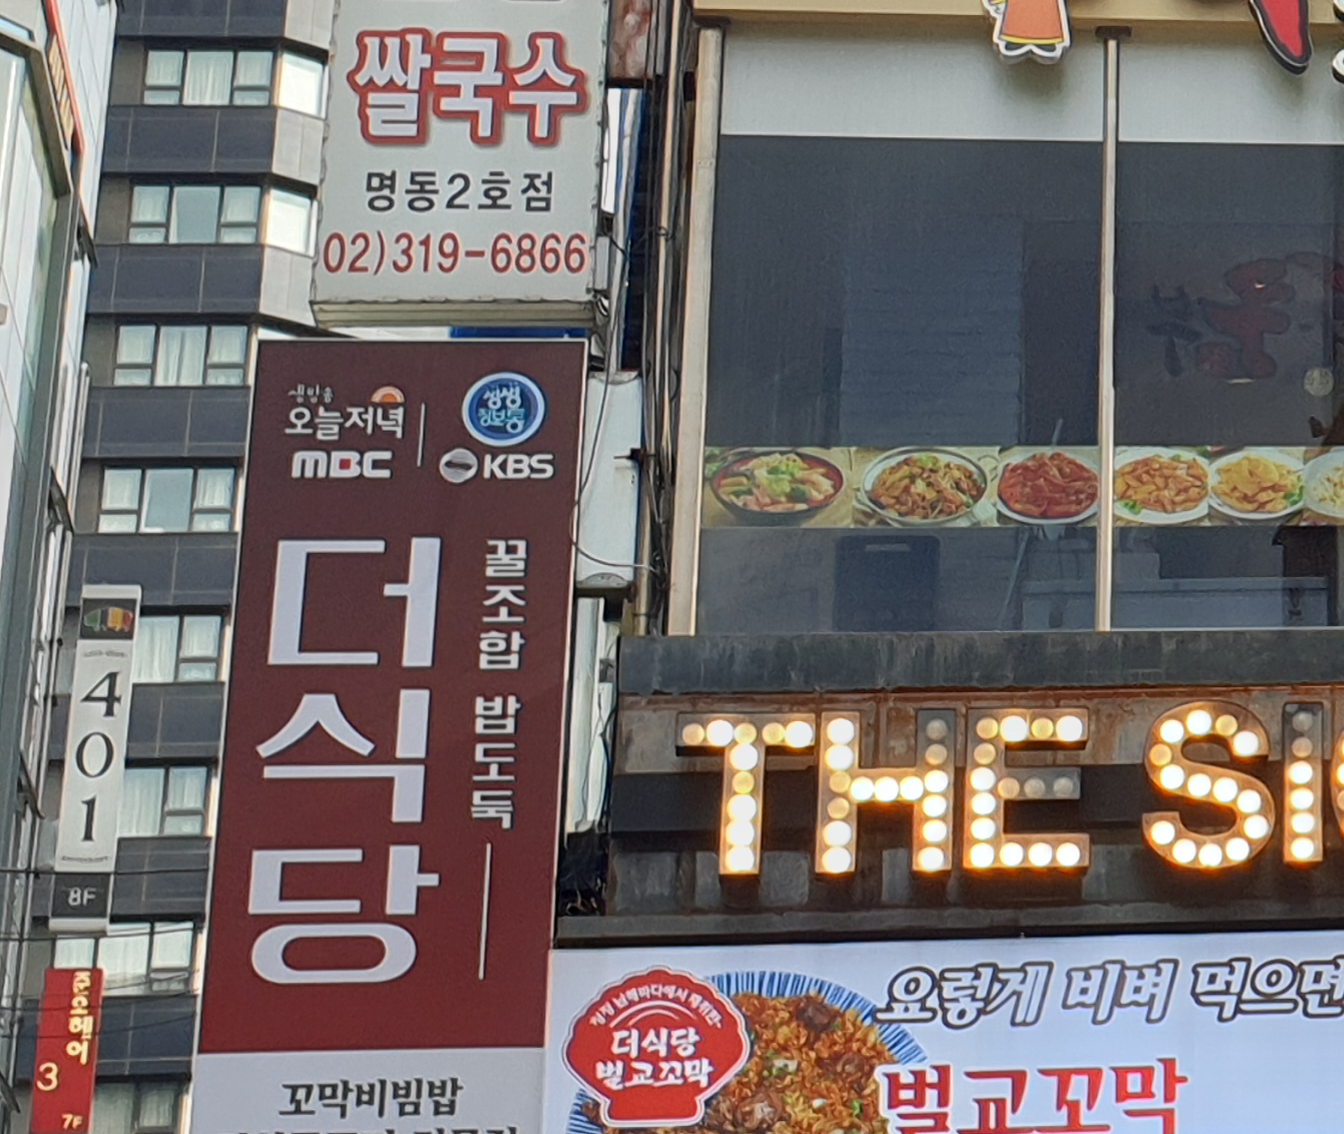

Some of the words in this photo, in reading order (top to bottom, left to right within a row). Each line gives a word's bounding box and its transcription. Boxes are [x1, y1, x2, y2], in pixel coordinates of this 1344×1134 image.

[347, 27, 587, 147] 쌀국수
[366, 170, 554, 213] 명동2호점
[322, 232, 588, 276] 02)319-6866
[284, 405, 405, 441] 오늘저녁
[291, 450, 393, 479] MBC
[483, 453, 554, 479] KBS
[478, 538, 528, 670] 꿀조합
[75, 671, 122, 843] 401
[248, 537, 441, 985] 더식당
[470, 695, 522, 830] 밥도둑
[676, 706, 1090, 878] THE
[67, 888, 97, 908] 8F
[874, 959, 1057, 1029] 요렇게
[1062, 958, 1180, 1025] 비벼
[611, 1026, 700, 1059] 더식당
[595, 1057, 714, 1091] 벌교꼬막
[882, 1056, 1190, 1134] 벌교꼬막
[278, 1077, 464, 1118] 꼬막비빔밥
